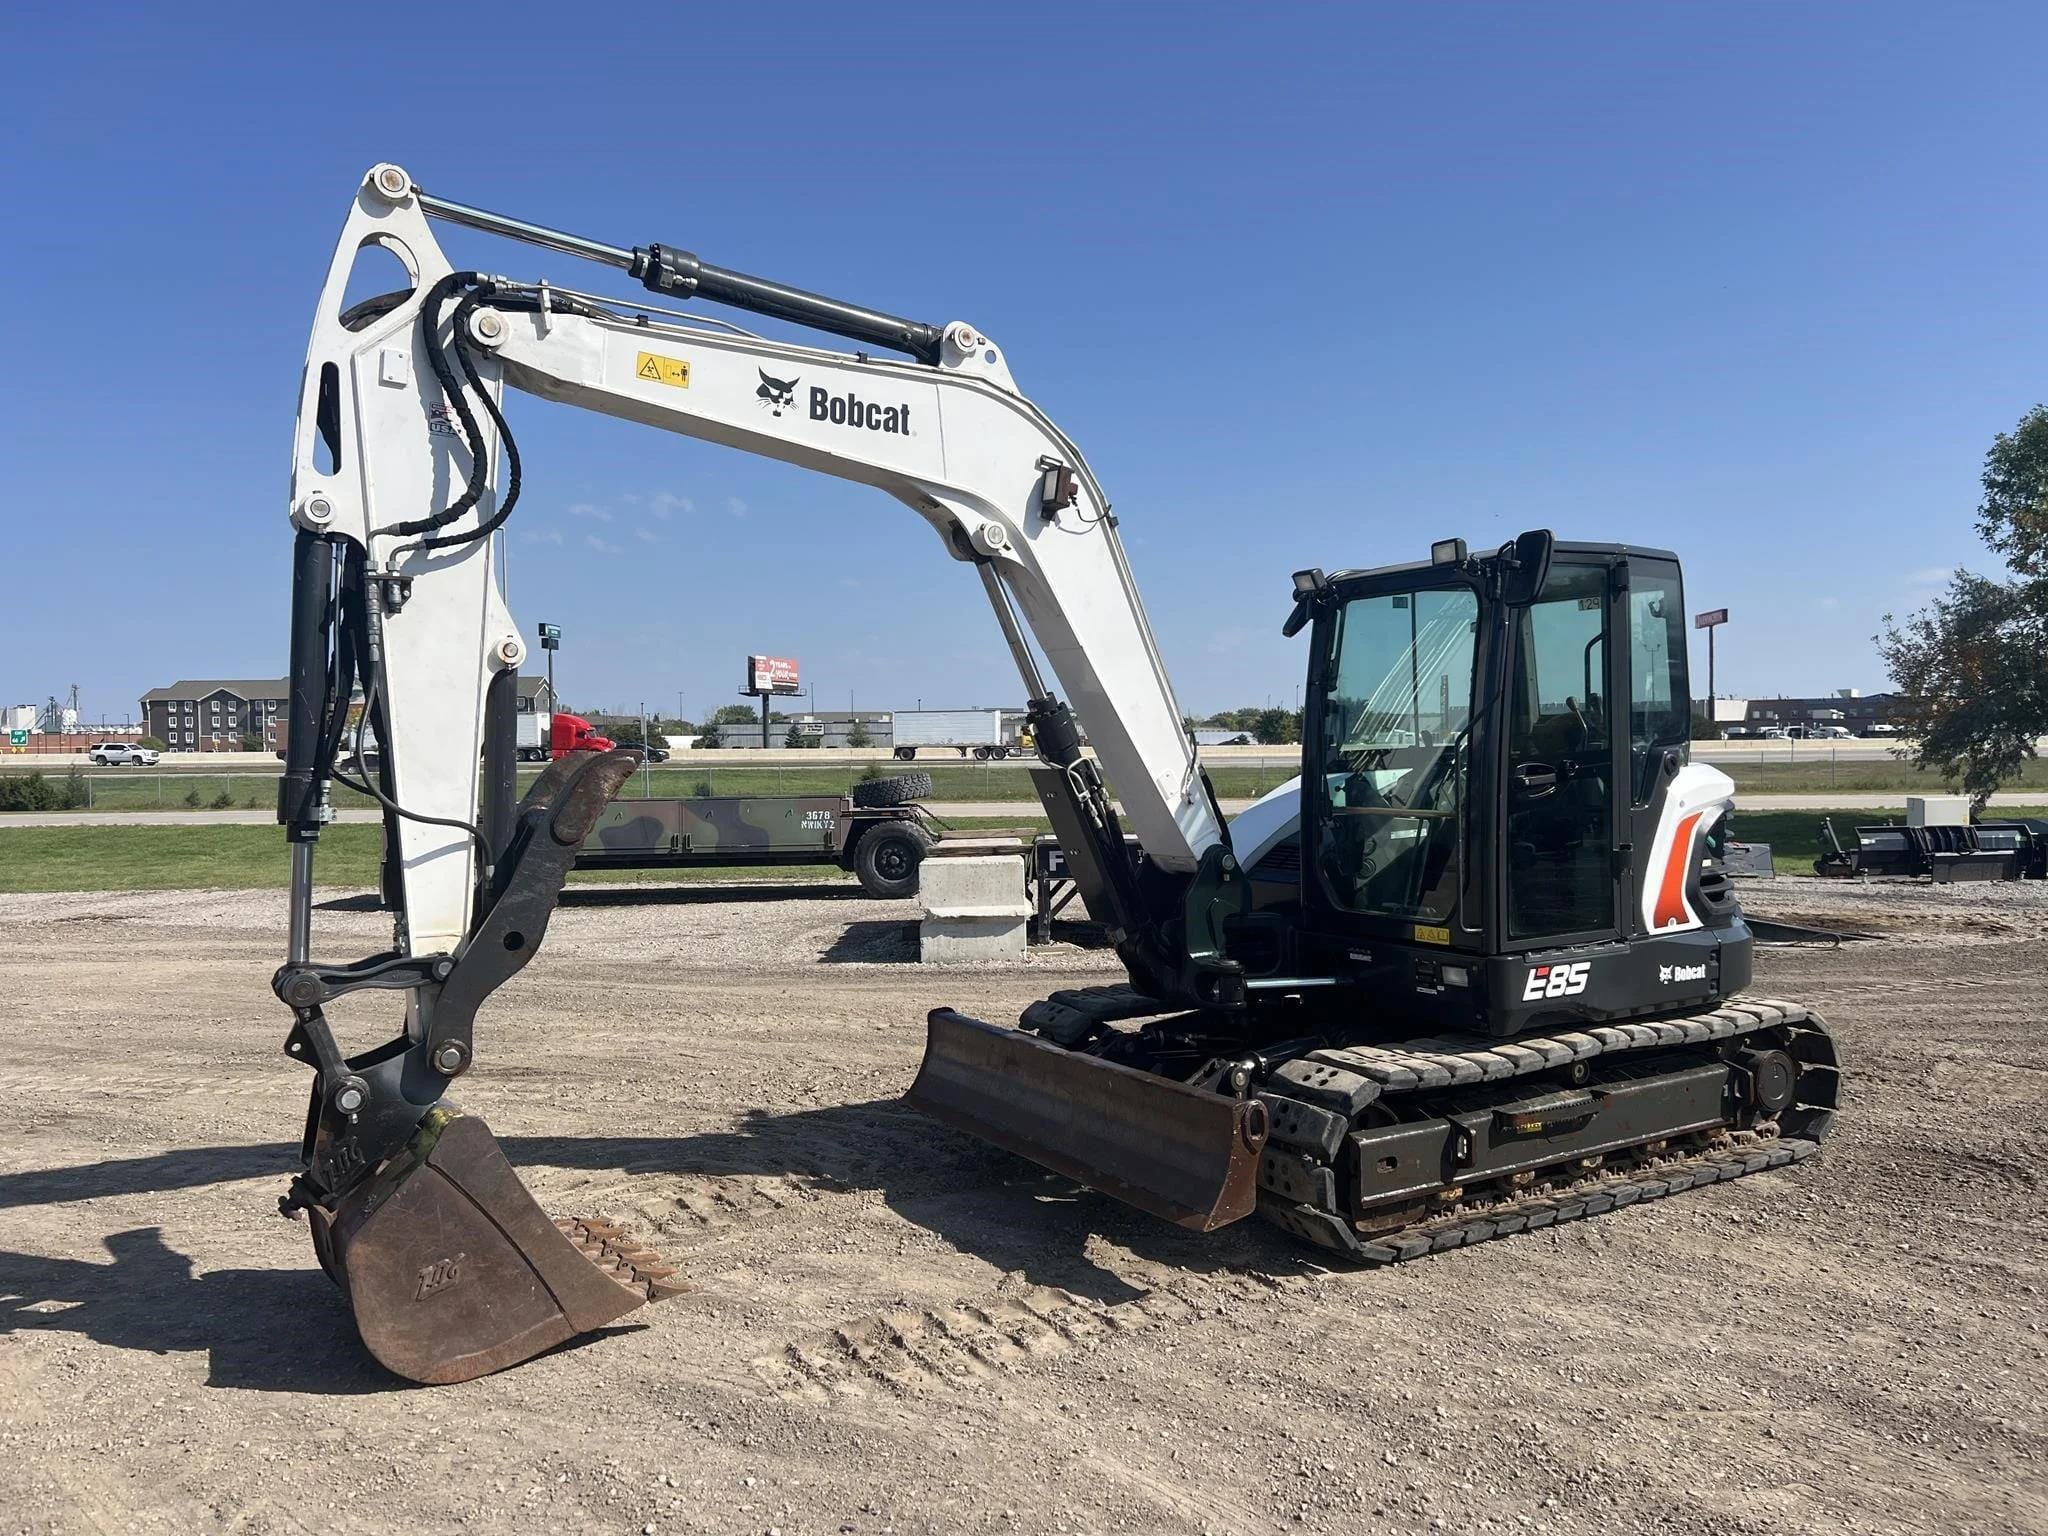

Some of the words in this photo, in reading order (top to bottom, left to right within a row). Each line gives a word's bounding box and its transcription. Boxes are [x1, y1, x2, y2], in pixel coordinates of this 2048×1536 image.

[809, 386, 911, 436] Bobcat
[1522, 961, 1592, 1002] E85
[1674, 963, 1706, 982] Bobcat
